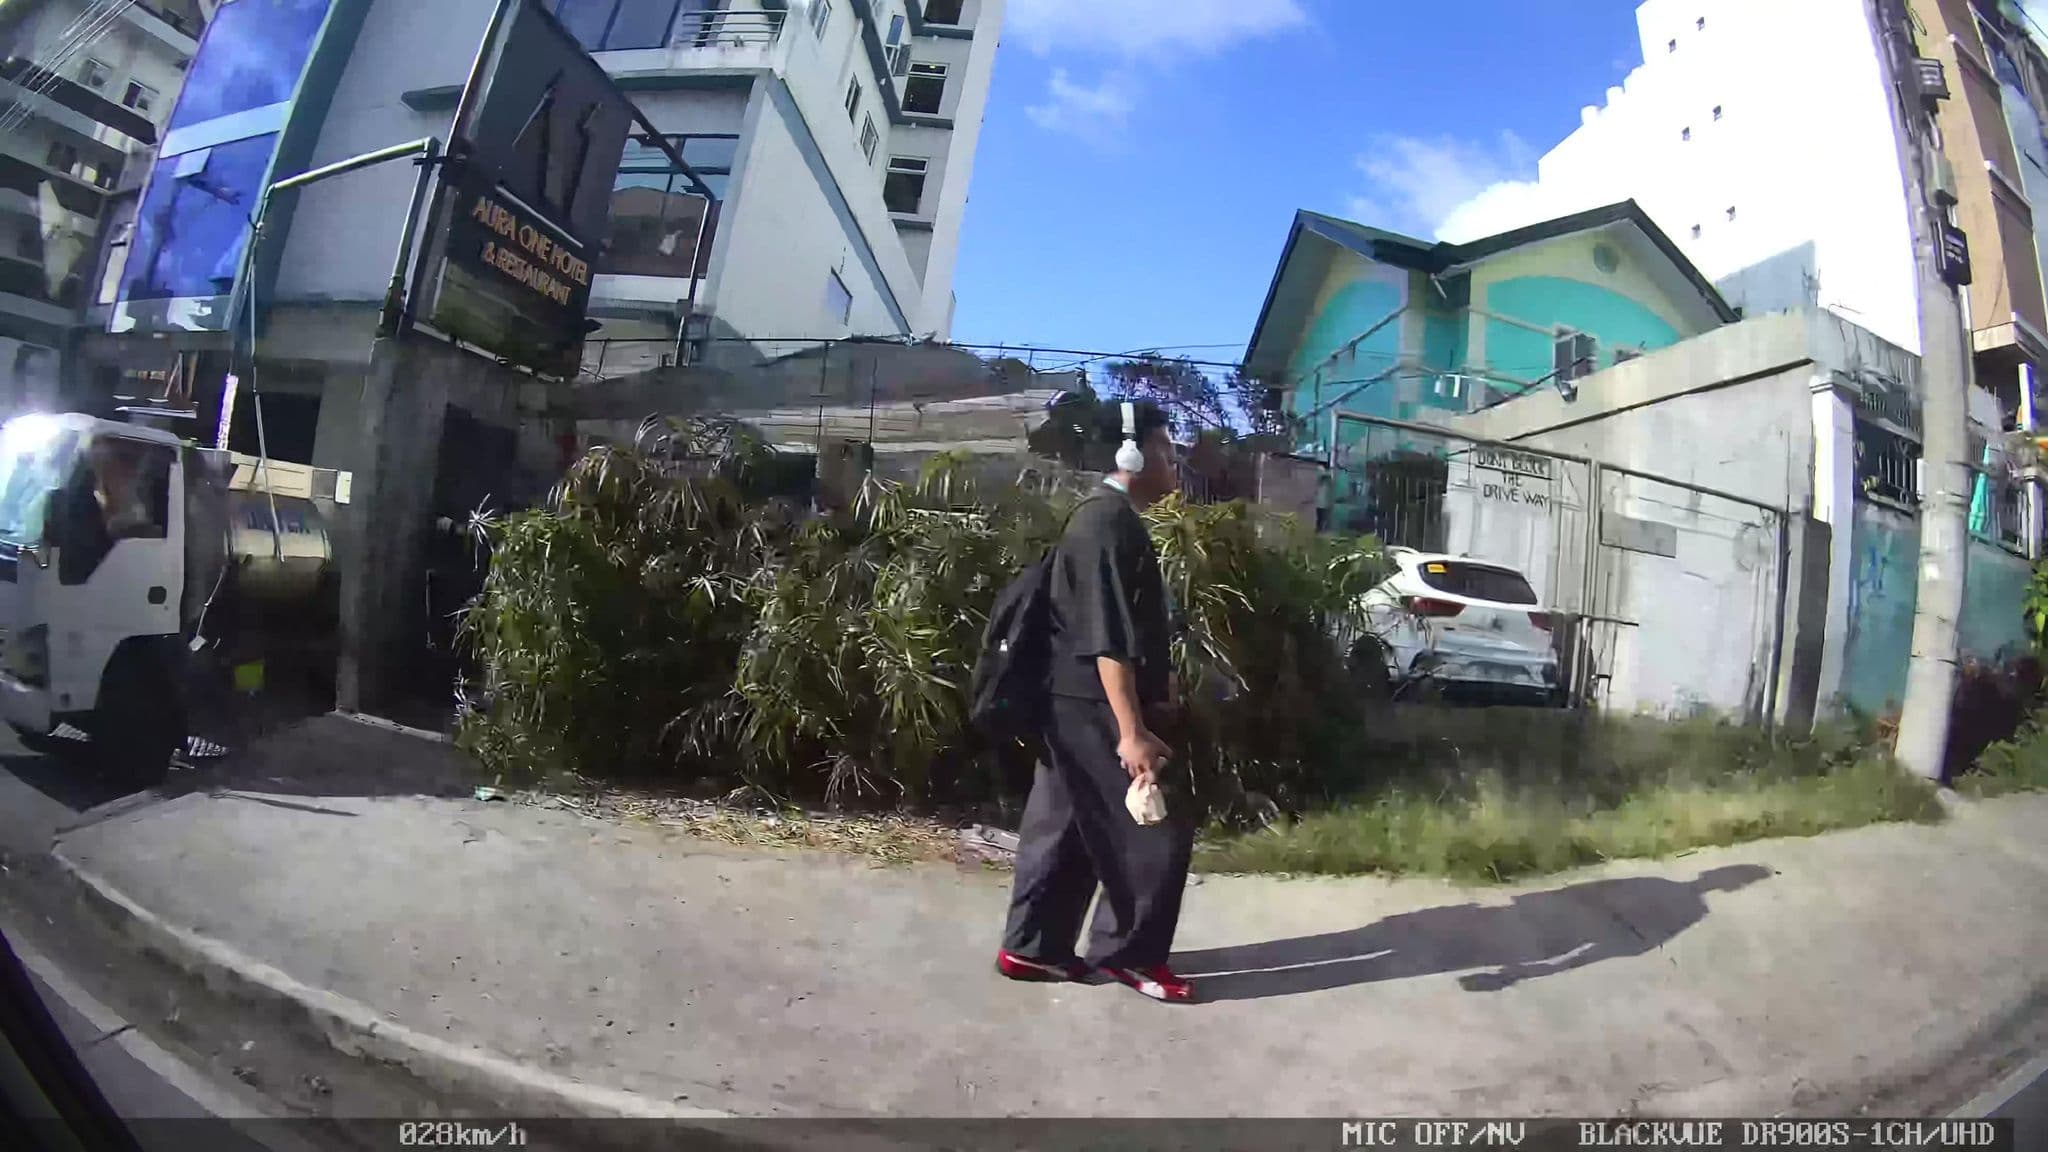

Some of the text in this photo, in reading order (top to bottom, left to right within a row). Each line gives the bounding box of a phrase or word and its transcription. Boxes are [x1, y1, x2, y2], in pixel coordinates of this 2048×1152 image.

[473, 196, 588, 287] AURA ONE HOTEL
[483, 241, 572, 306] & RESTAURANT
[1483, 484, 1551, 508] DRIVE WAY
[1502, 470, 1522, 487] THE
